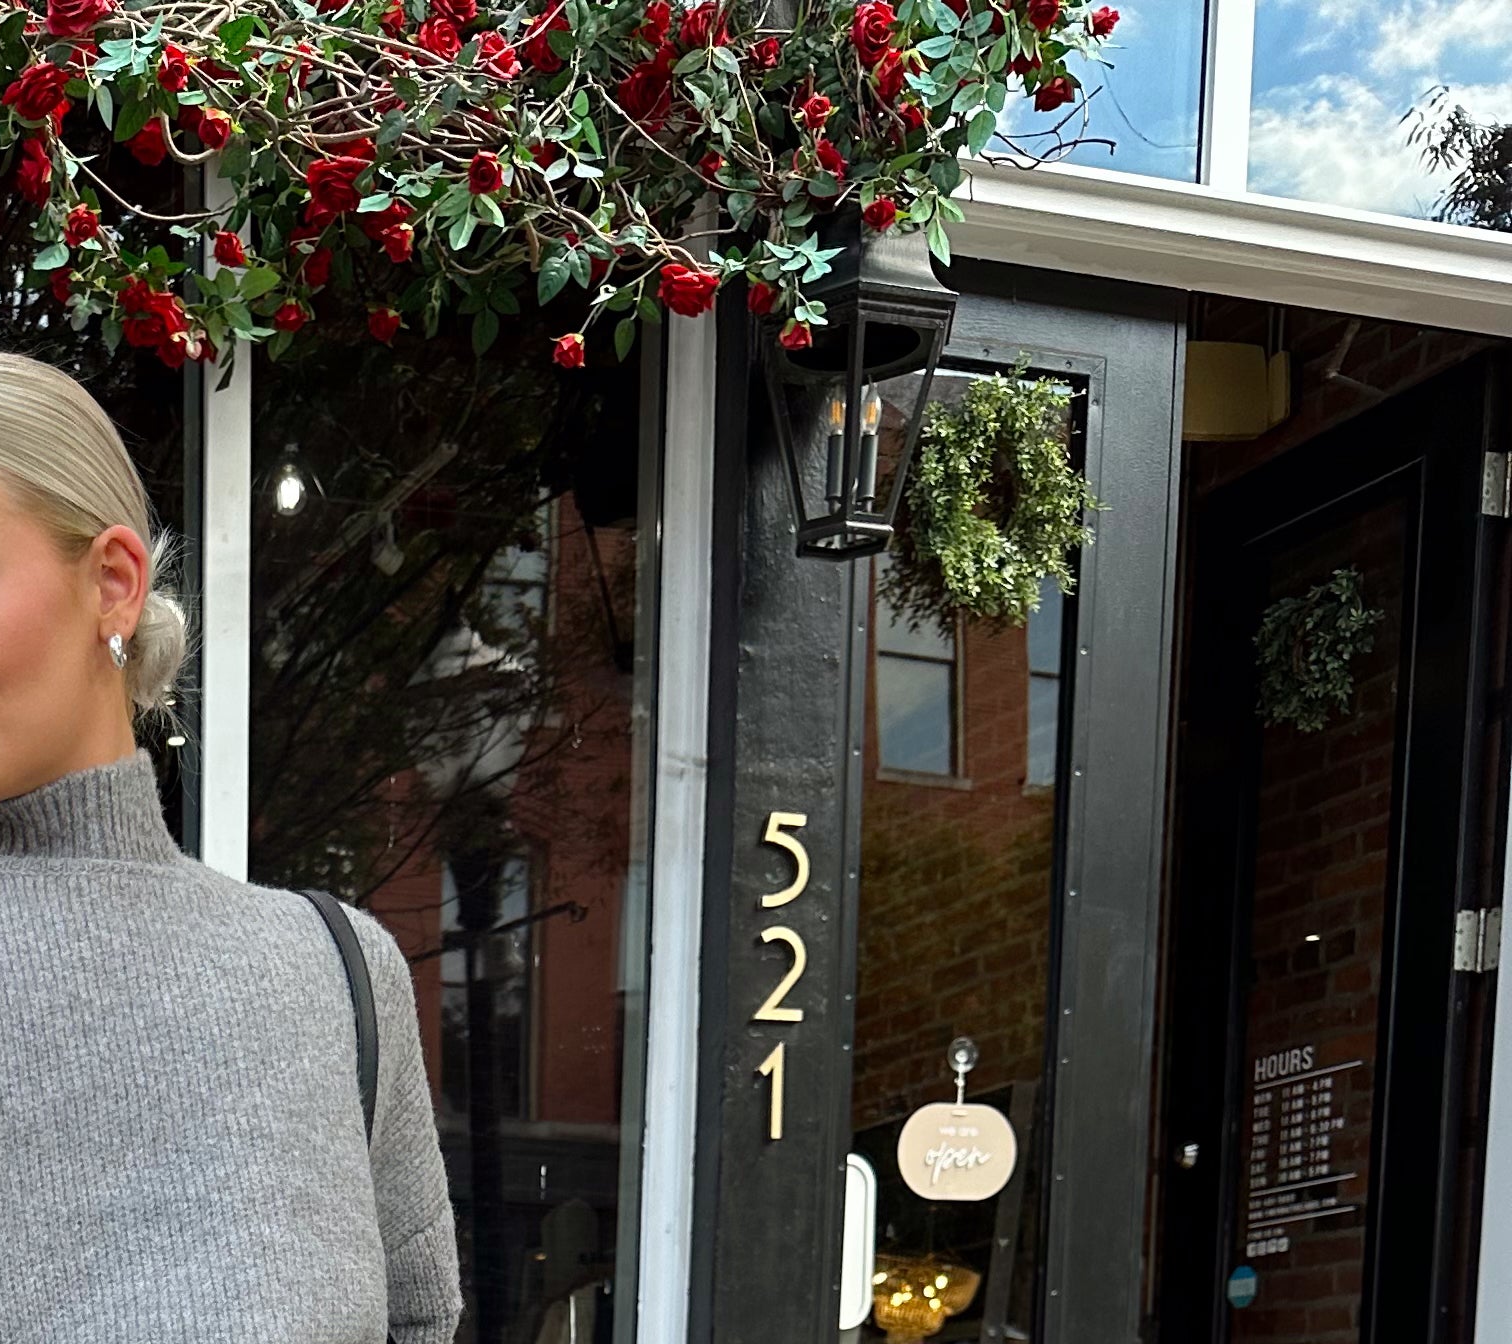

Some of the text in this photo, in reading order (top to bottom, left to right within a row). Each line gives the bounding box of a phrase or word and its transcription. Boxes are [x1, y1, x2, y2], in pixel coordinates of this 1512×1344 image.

[753, 811, 810, 1140] 521
[1254, 1045, 1314, 1082] HOURS
[925, 1140, 992, 1185] open
